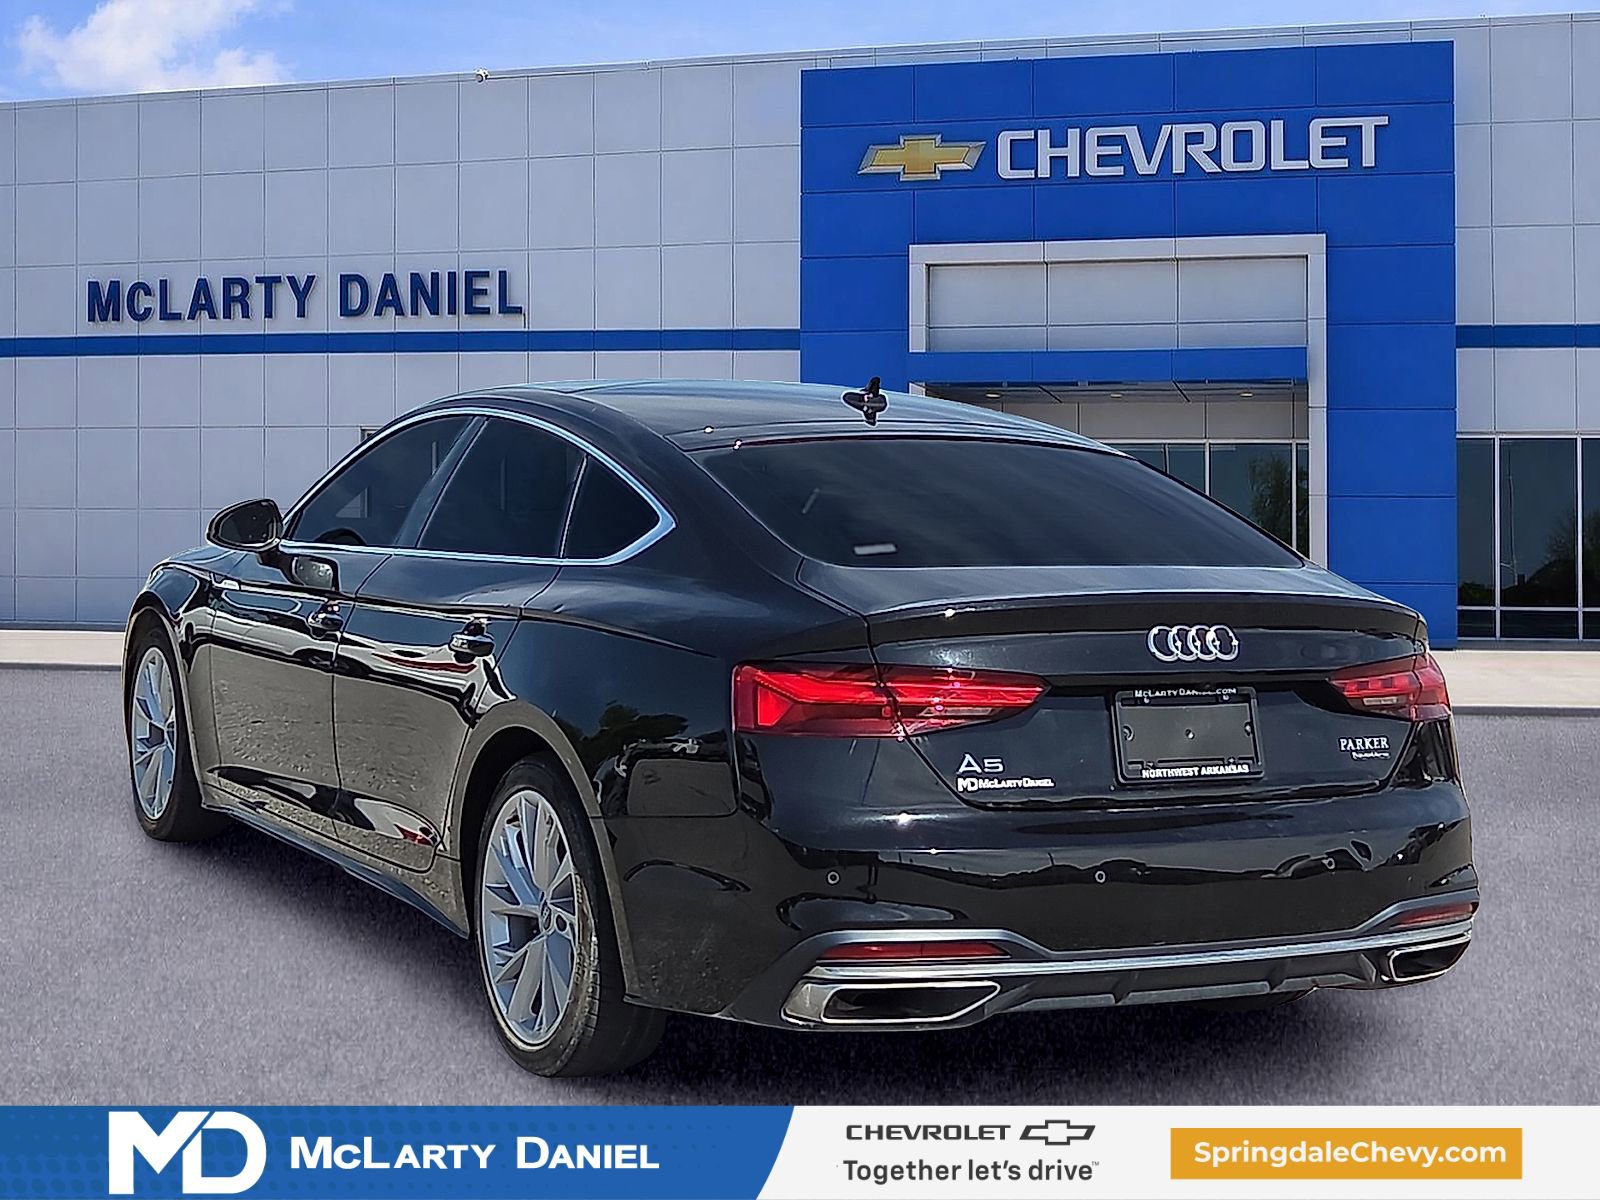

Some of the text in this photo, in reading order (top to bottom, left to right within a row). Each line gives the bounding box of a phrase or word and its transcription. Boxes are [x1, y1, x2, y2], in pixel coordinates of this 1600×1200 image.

[997, 115, 1389, 180] CHEVROLET
[339, 270, 525, 319] DANIEL
[1339, 737, 1389, 751] PARKER
[957, 753, 1004, 774] A5
[1141, 764, 1249, 779] NORTHWEST ARKANSAS
